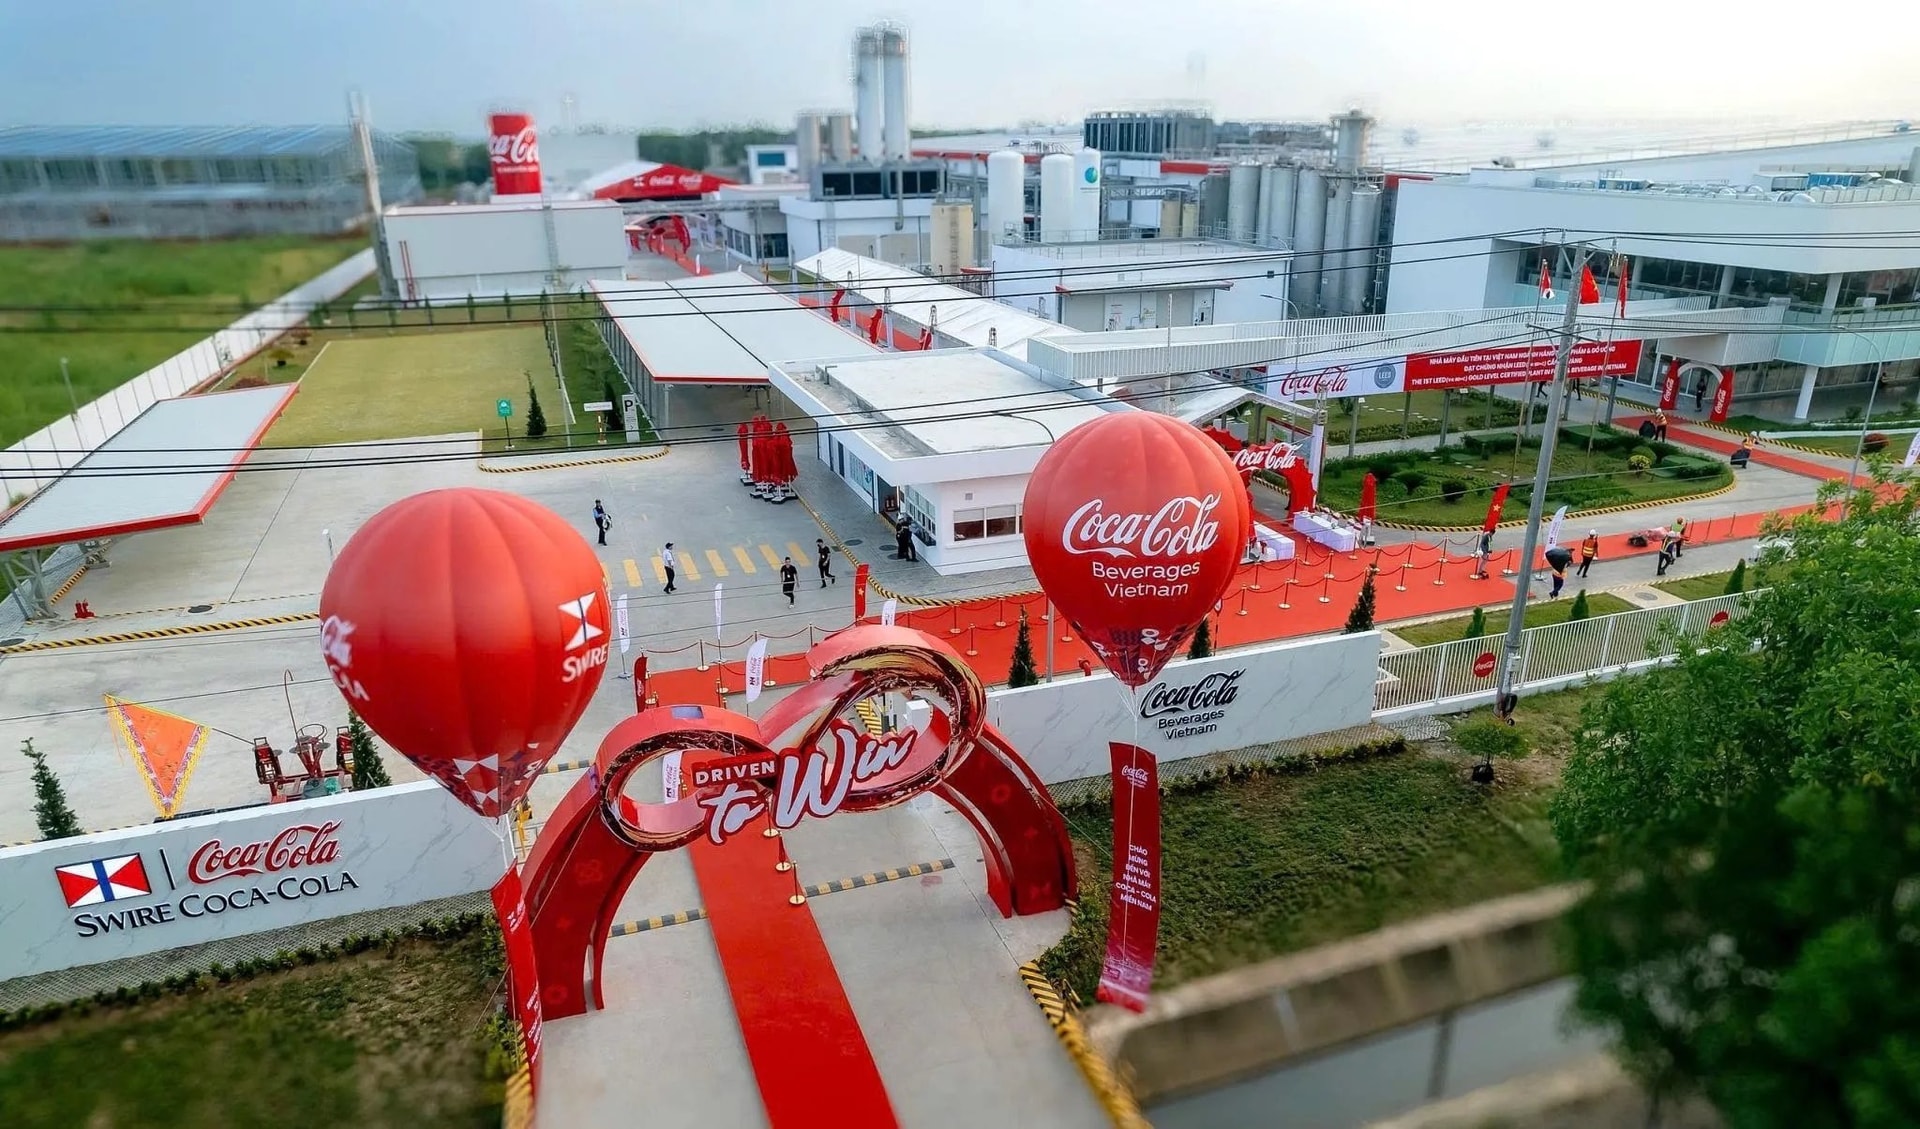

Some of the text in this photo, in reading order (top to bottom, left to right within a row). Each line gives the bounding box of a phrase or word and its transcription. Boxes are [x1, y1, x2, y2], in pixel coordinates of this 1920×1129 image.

[1504, 352, 1518, 360] NAM
[1281, 365, 1349, 396] Coca-Cola
[1468, 373, 1484, 381] GOLD
[1484, 372, 1499, 380] LEVEL
[1232, 442, 1303, 473] Coca-Cola
[1062, 492, 1221, 558] Coca-Cola
[1092, 561, 1201, 581] Beverages
[1104, 582, 1189, 598] Vietnam
[1140, 668, 1246, 718] Coca-Cola
[1157, 709, 1225, 729] Beverages
[1164, 722, 1217, 740] Vietnam
[695, 760, 775, 785] DRIVEN
[700, 728, 918, 844] to Win
[187, 820, 342, 884] Coca-Cola
[73, 870, 361, 938] SWIRE COCA-COLA
[1115, 882, 1136, 895] COCA
[1140, 889, 1157, 904] COLA
